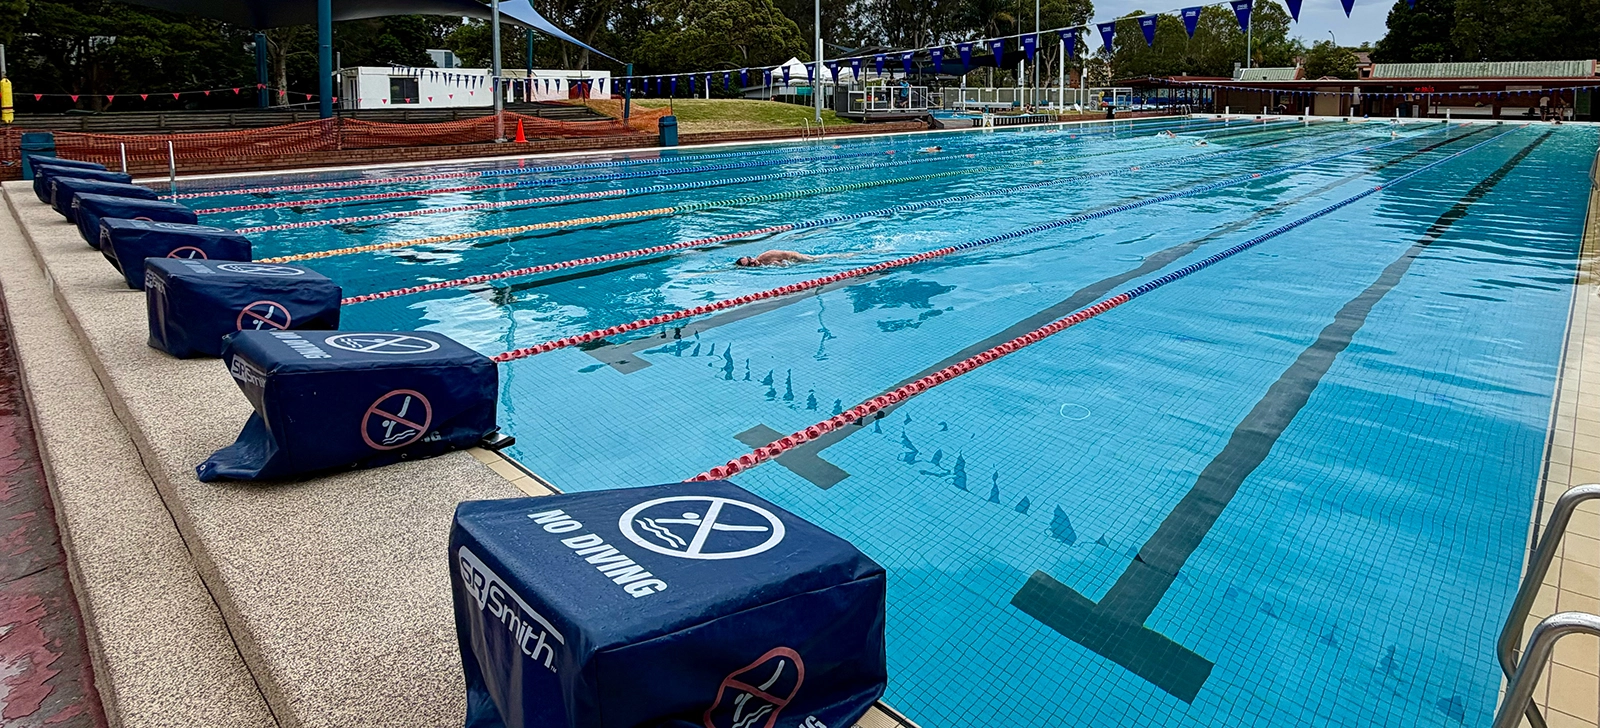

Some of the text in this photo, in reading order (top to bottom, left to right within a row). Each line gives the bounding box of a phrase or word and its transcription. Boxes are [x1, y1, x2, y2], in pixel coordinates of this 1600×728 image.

[527, 509, 668, 598] NO DIVING
[460, 556, 487, 606] SR
[487, 584, 555, 668] Smith
